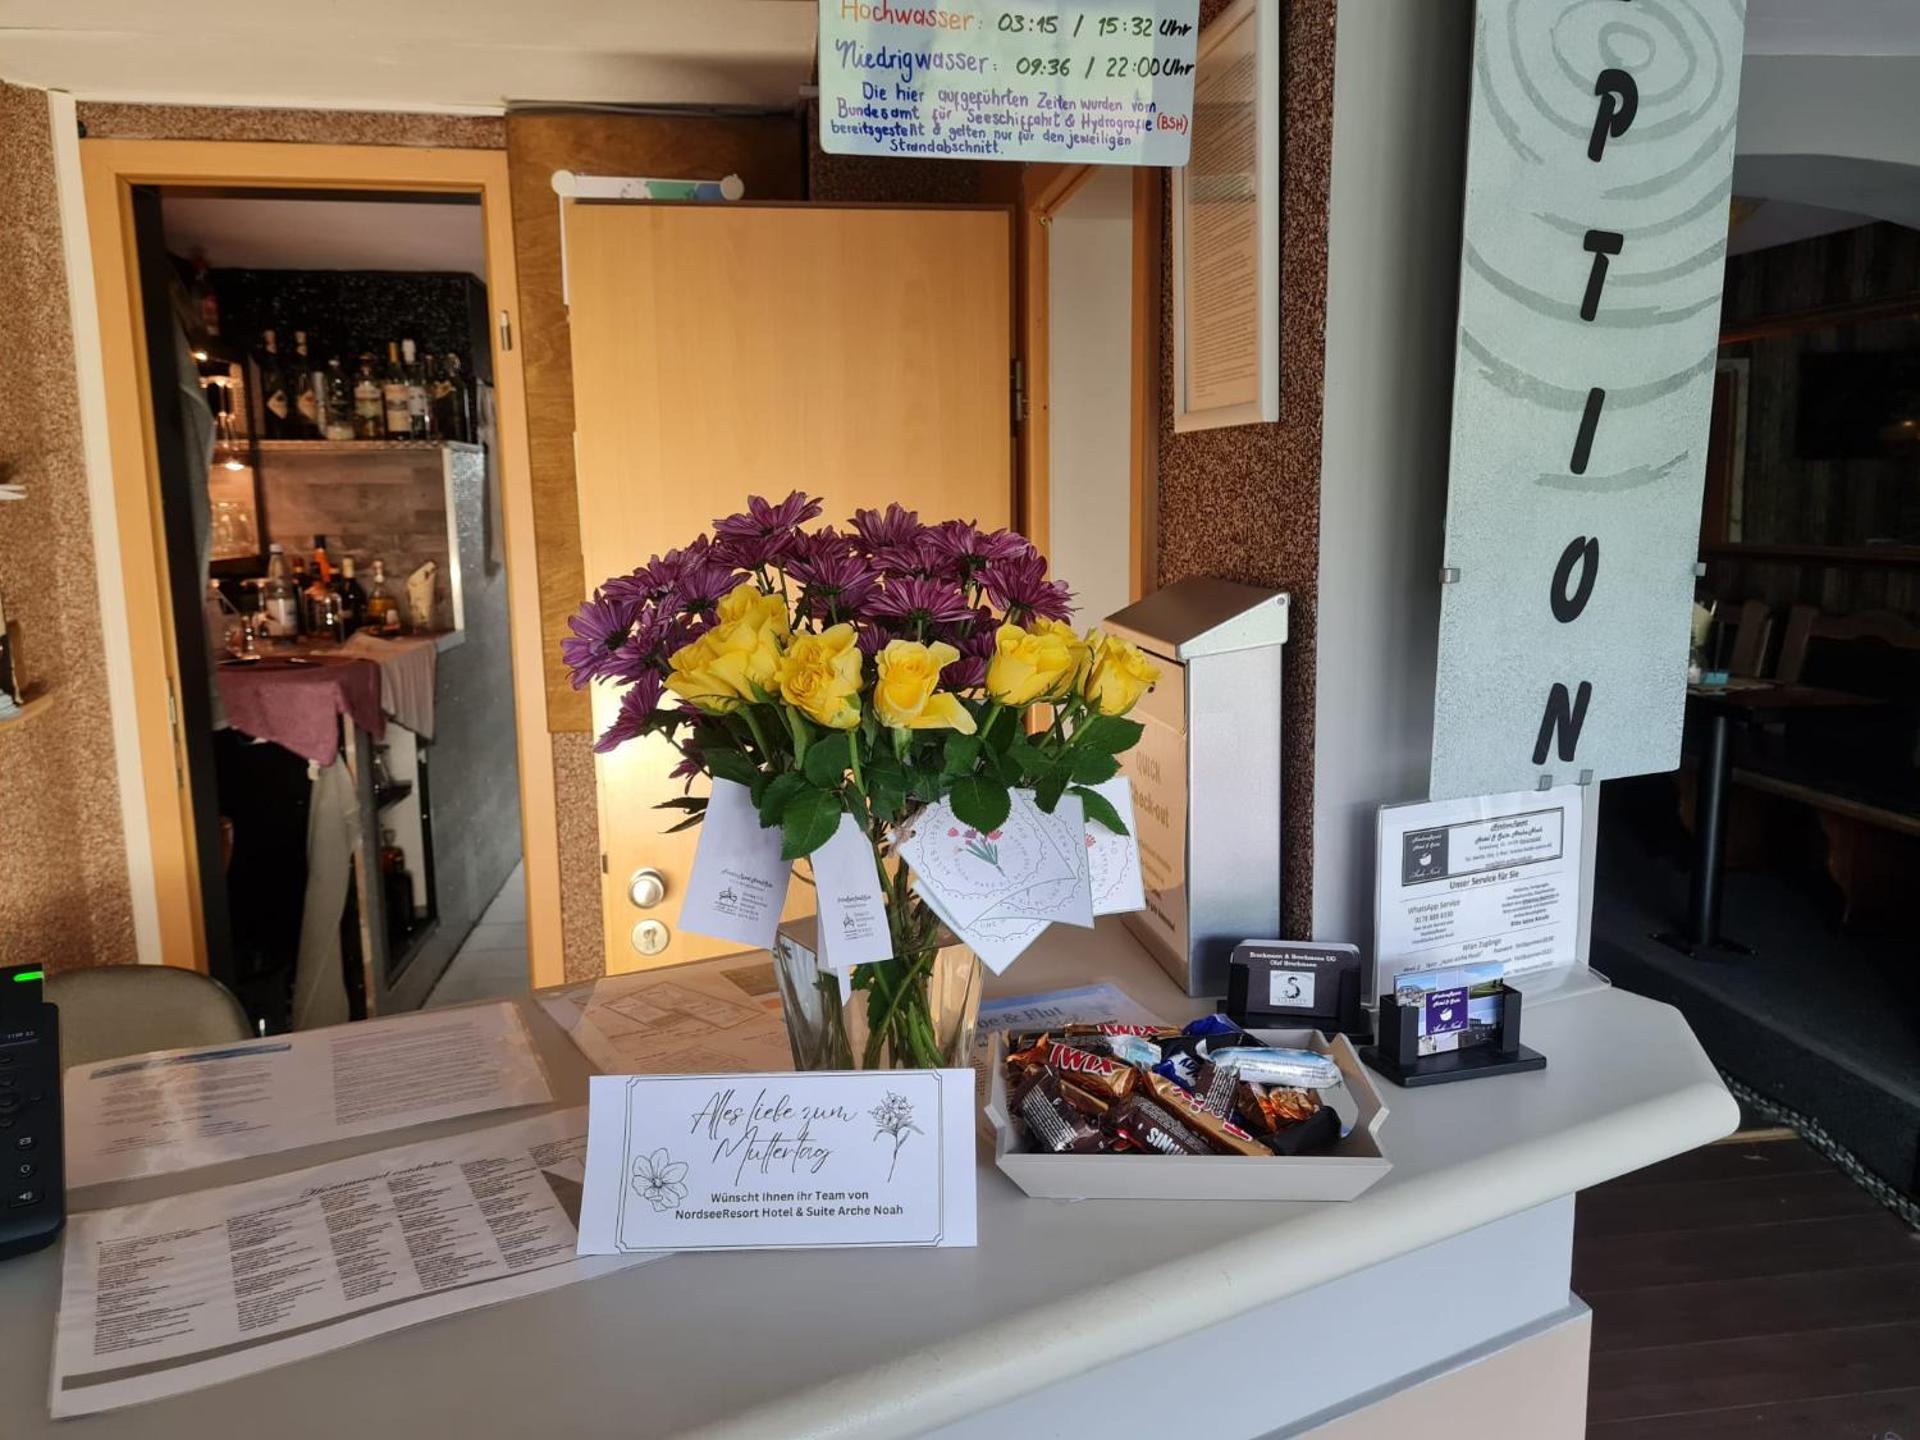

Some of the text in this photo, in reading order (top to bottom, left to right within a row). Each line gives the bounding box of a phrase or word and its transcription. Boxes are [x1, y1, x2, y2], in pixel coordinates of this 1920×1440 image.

[998, 13, 1059, 34] 03:15
[1073, 14, 1085, 38] /
[1098, 16, 1153, 37] 15:32
[1159, 18, 1192, 37] Uhr
[1016, 57, 1071, 77] 09:36
[1085, 56, 1095, 79] /
[1106, 57, 1160, 78] 22:00
[1163, 58, 1195, 76] Uhr
[862, 82, 1157, 113] Die hier aufgeführten Zeiten wurden vom
[836, 97, 920, 120] Bundesamt
[932, 105, 952, 122] für
[1065, 114, 1076, 128] &
[1081, 113, 1153, 135] Hydrografie
[1156, 112, 1189, 135] (BSH)
[831, 119, 925, 143] bereitsgestellt
[948, 124, 987, 141] gelten
[994, 131, 1012, 141] nur
[1018, 130, 1035, 144] für
[1042, 130, 1065, 142] den
[1068, 130, 1131, 150] jeweiligen
[889, 138, 1004, 155] Strandabschnitt.
[1050, 1042, 1114, 1076] TWIX
[712, 1126, 837, 1187] Muttertag
[711, 1190, 869, 1204] Wünscht Ihnen ihr Team von
[675, 1204, 904, 1221] NordseeResort Hotel & Suite Arche Noah
